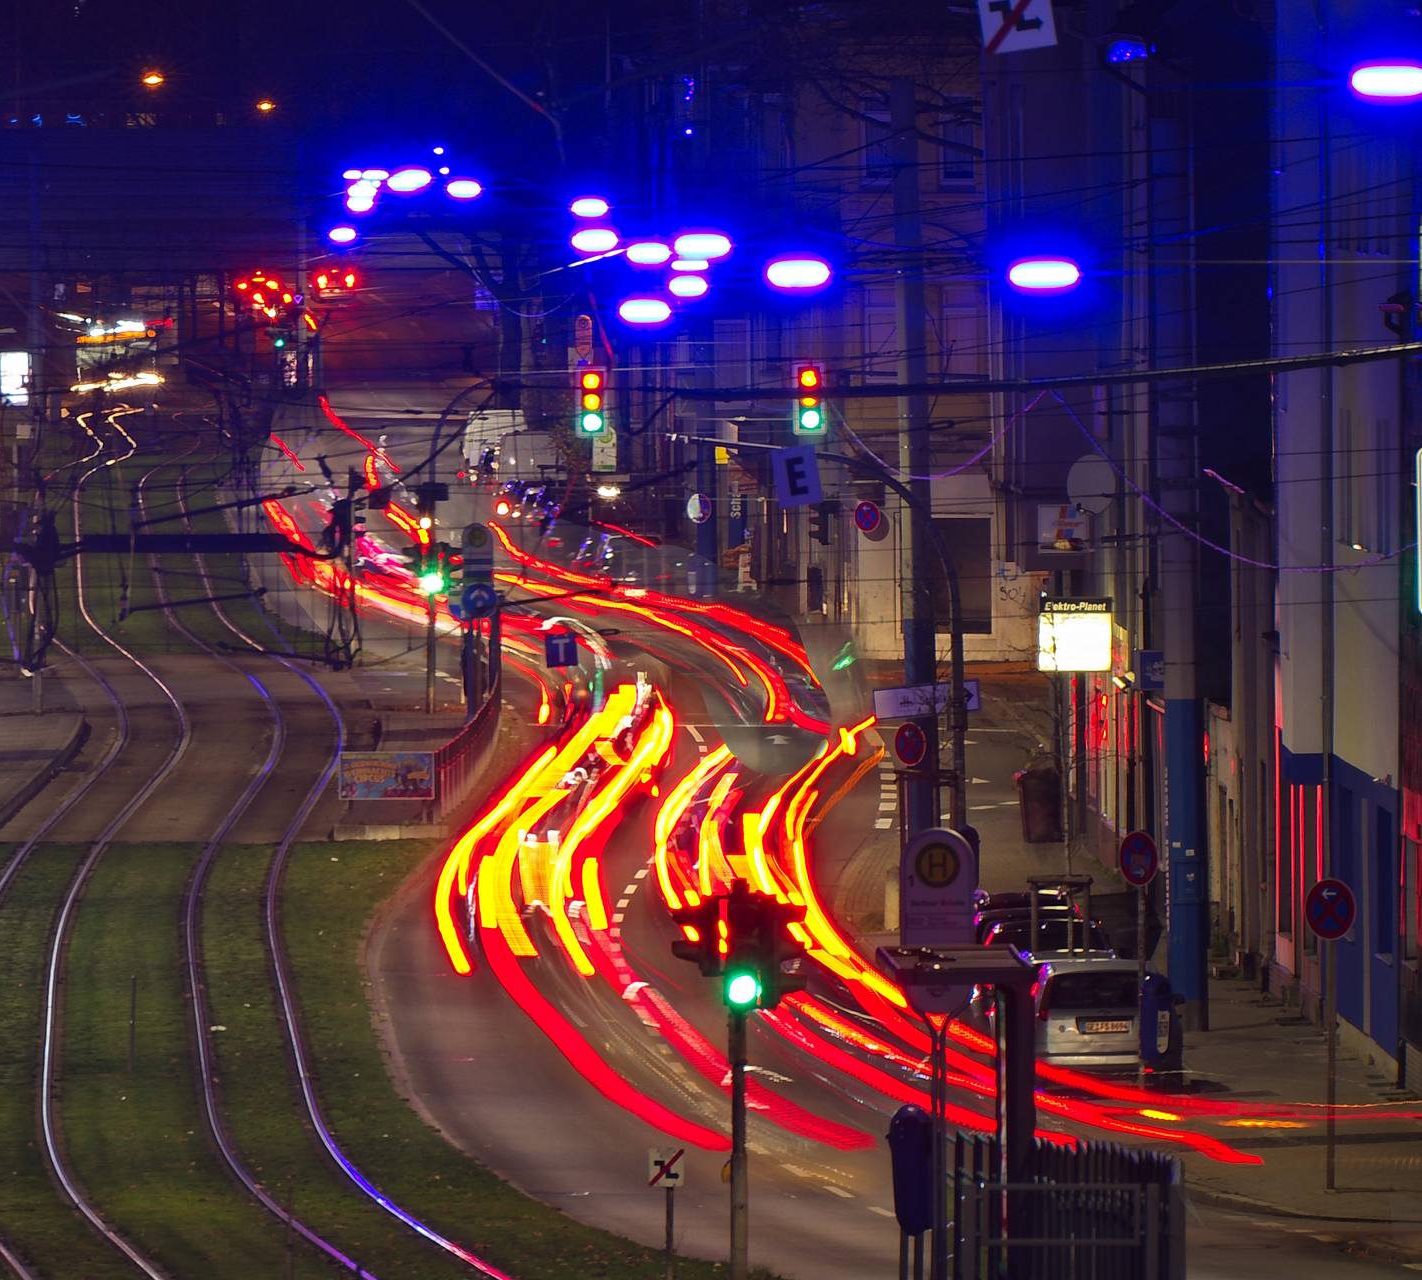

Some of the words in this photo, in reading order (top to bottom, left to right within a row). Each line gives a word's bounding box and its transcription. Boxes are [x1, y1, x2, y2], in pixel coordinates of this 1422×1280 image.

[785, 456, 810, 497] E
[1044, 601, 1107, 612] Eektro-Planet
[551, 638, 571, 663] T
[928, 853, 947, 878] H
